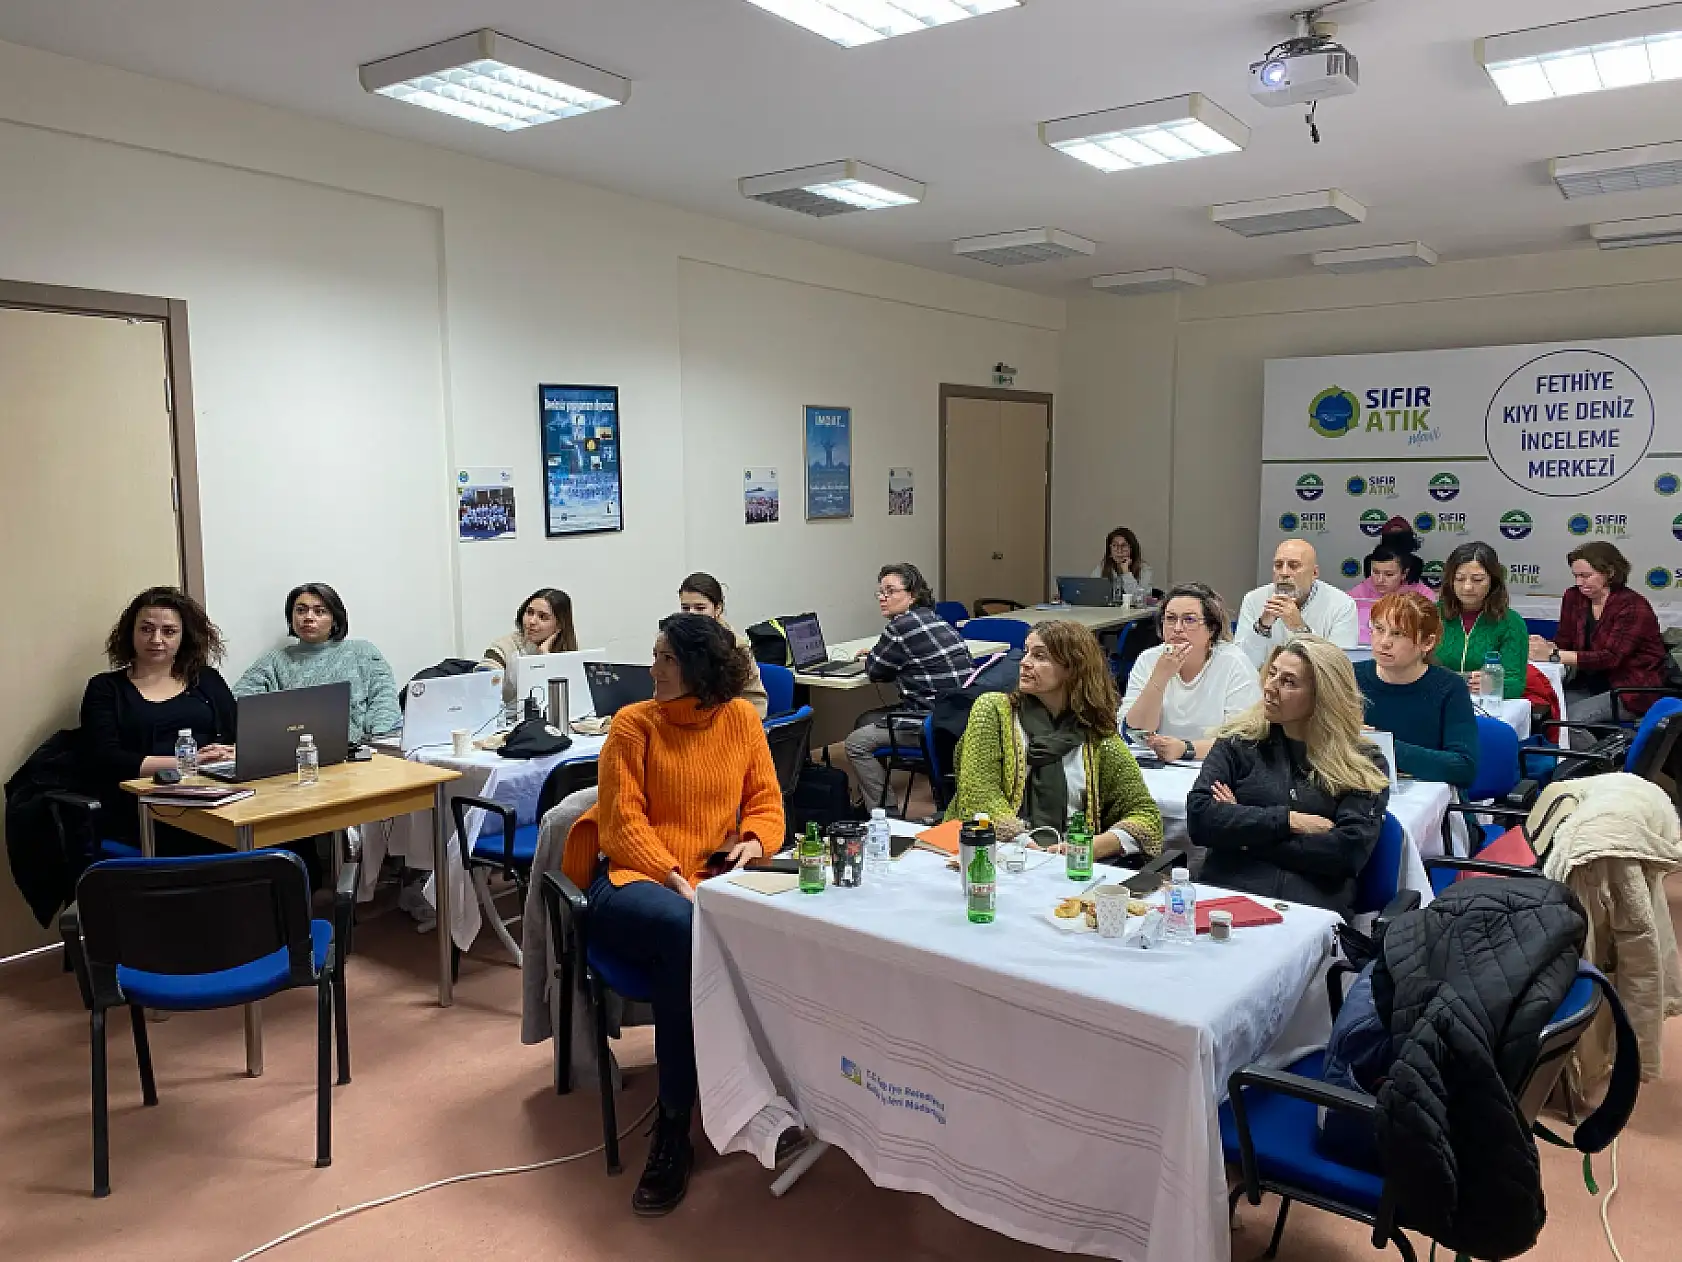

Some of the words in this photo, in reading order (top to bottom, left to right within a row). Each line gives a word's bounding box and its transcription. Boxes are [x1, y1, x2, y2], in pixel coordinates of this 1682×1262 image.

[1536, 369, 1615, 394] FETHİYE
[1365, 386, 1431, 409] SIFIR
[1503, 404, 1538, 423] KIYI
[1545, 403, 1569, 421] VE
[1576, 395, 1635, 420] DENİZ
[1365, 410, 1431, 432] ATIK
[1521, 429, 1620, 451] İNCELEME
[1528, 454, 1615, 479] MERKEZİ
[1368, 475, 1396, 486] SIFIR
[1595, 514, 1628, 525] SIFIR
[1510, 564, 1541, 574] SIFIR
